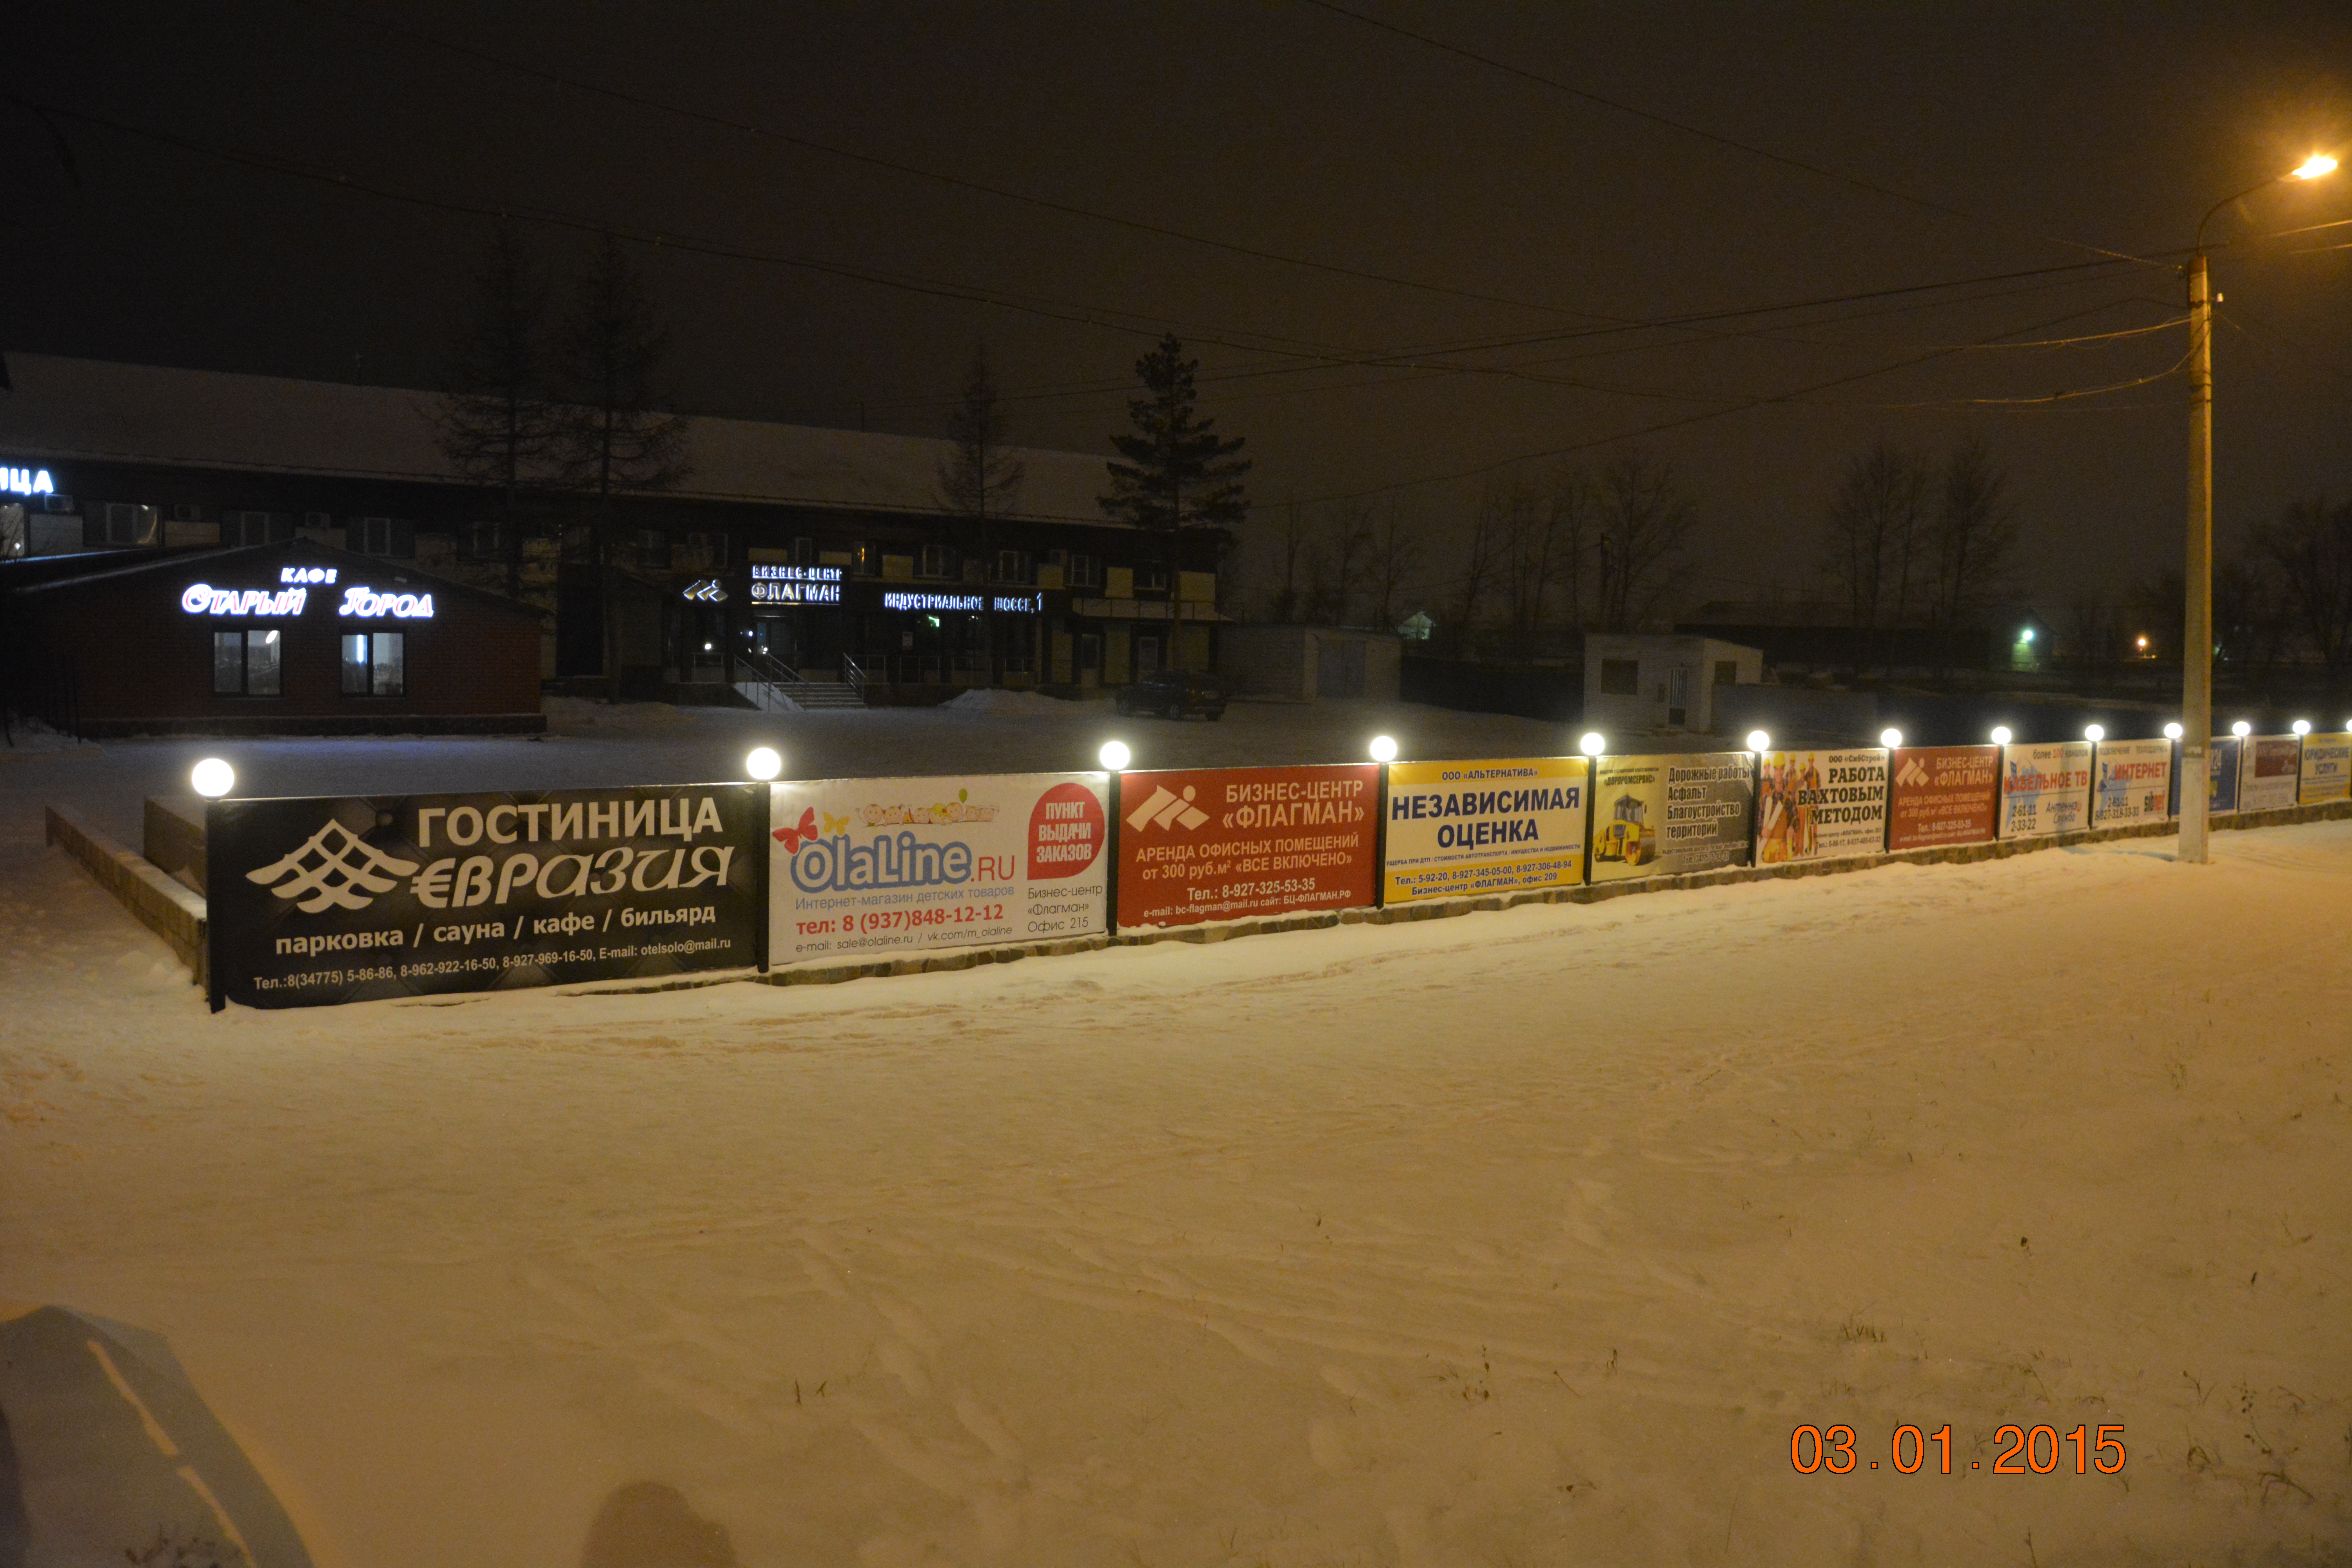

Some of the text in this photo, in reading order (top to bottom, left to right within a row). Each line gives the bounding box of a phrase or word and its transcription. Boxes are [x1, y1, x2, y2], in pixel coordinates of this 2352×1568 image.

[281, 567, 337, 584] КАФЕ
[752, 565, 842, 581] БИЗНЕС-ЦЕНТР
[751, 581, 840, 601] ФЛАГМАН
[885, 592, 984, 611] ИНДУСТРИАЛЬНОЕ
[1845, 755, 1885, 763] «СибСтрой»
[1936, 756, 1993, 769] БИЗНЕС-ЦЕНТР
[2033, 749, 2051, 759] более
[2053, 748, 2063, 759] 100
[1442, 768, 1538, 780] ООО «АЛЬТЕРНАТИВА»
[1669, 767, 1716, 784] Дорожные
[1718, 765, 1750, 781] работы
[1829, 766, 1885, 784] РАБОТА
[1934, 769, 1993, 786] «ФЛАГМАН»
[2114, 762, 2167, 781] ИНТЕРНЕТ
[1226, 780, 1363, 803] БИЗНЕС-ЦЕНТР
[2004, 771, 2088, 793] КАБЕЛЬНОЕ ТВ
[1392, 787, 1580, 820] НЕЗАВИСИМАЯ
[1668, 786, 1707, 801] Асфальт
[1798, 785, 1884, 805] ВАХТОВЫМ
[1045, 802, 1085, 820] ПУНКТ
[1222, 801, 1364, 829] «ФЛАГМАН»
[1668, 800, 1740, 820] Благоустройство
[1811, 805, 1883, 825] МЕТОДОМ
[2012, 804, 2037, 817] 2-61-11
[418, 797, 724, 848] ГОСТИНИЦА
[1038, 822, 1091, 842] ВЫДАЧИ
[1667, 820, 1718, 838] территорий
[2011, 818, 2036, 832] 2-33-22
[1437, 819, 1539, 850] ОЦЕНКА
[1036, 844, 1092, 863] ЗАКАЗОВ
[1136, 831, 1359, 862] АРЕНДА ОФИСНЫХ ПОМЕЩЕНИЙ
[1465, 850, 1508, 859] АВТОТРАНСПОРТА
[1142, 869, 1158, 880] от
[1162, 864, 1185, 878] 300
[1236, 857, 1269, 872] «ВСЕ
[1273, 852, 1352, 870] ВКЛЮЧЕНО»
[1395, 860, 1572, 885] Тел.: 5-92-20, 8-927-345-05-00, 8-927-306-48-94
[1028, 886, 1103, 899] Бизнес-центр
[1187, 878, 1315, 901] Тел.: 8-927-325-53-35
[1412, 872, 1557, 896] Бизнес-центр «ФЛАГМАН», офис 209
[796, 886, 1014, 911] Интернет-магазин детских товаров
[1143, 890, 1351, 917] e-mail: bc-flagman@mail.ru сайт: БЦ-ФЛАГМАН.РФ
[1028, 903, 1089, 915] «Флагман»
[796, 904, 1004, 935] тел: 8 (937)848-12-12
[1028, 917, 1089, 933] Офис 215
[276, 906, 716, 956] парковка / сауна / кафе / бильярд
[796, 942, 831, 952] e-mail:
[837, 935, 913, 949] sale@olaline.ru
[927, 926, 1012, 941] vk.com/m_olaline
[254, 939, 731, 989] Тел.:8(34775) 5-86-86, 8-962-922-16-50, 8-927-969-16-50, E-mail: otelsolo@mail.ru
